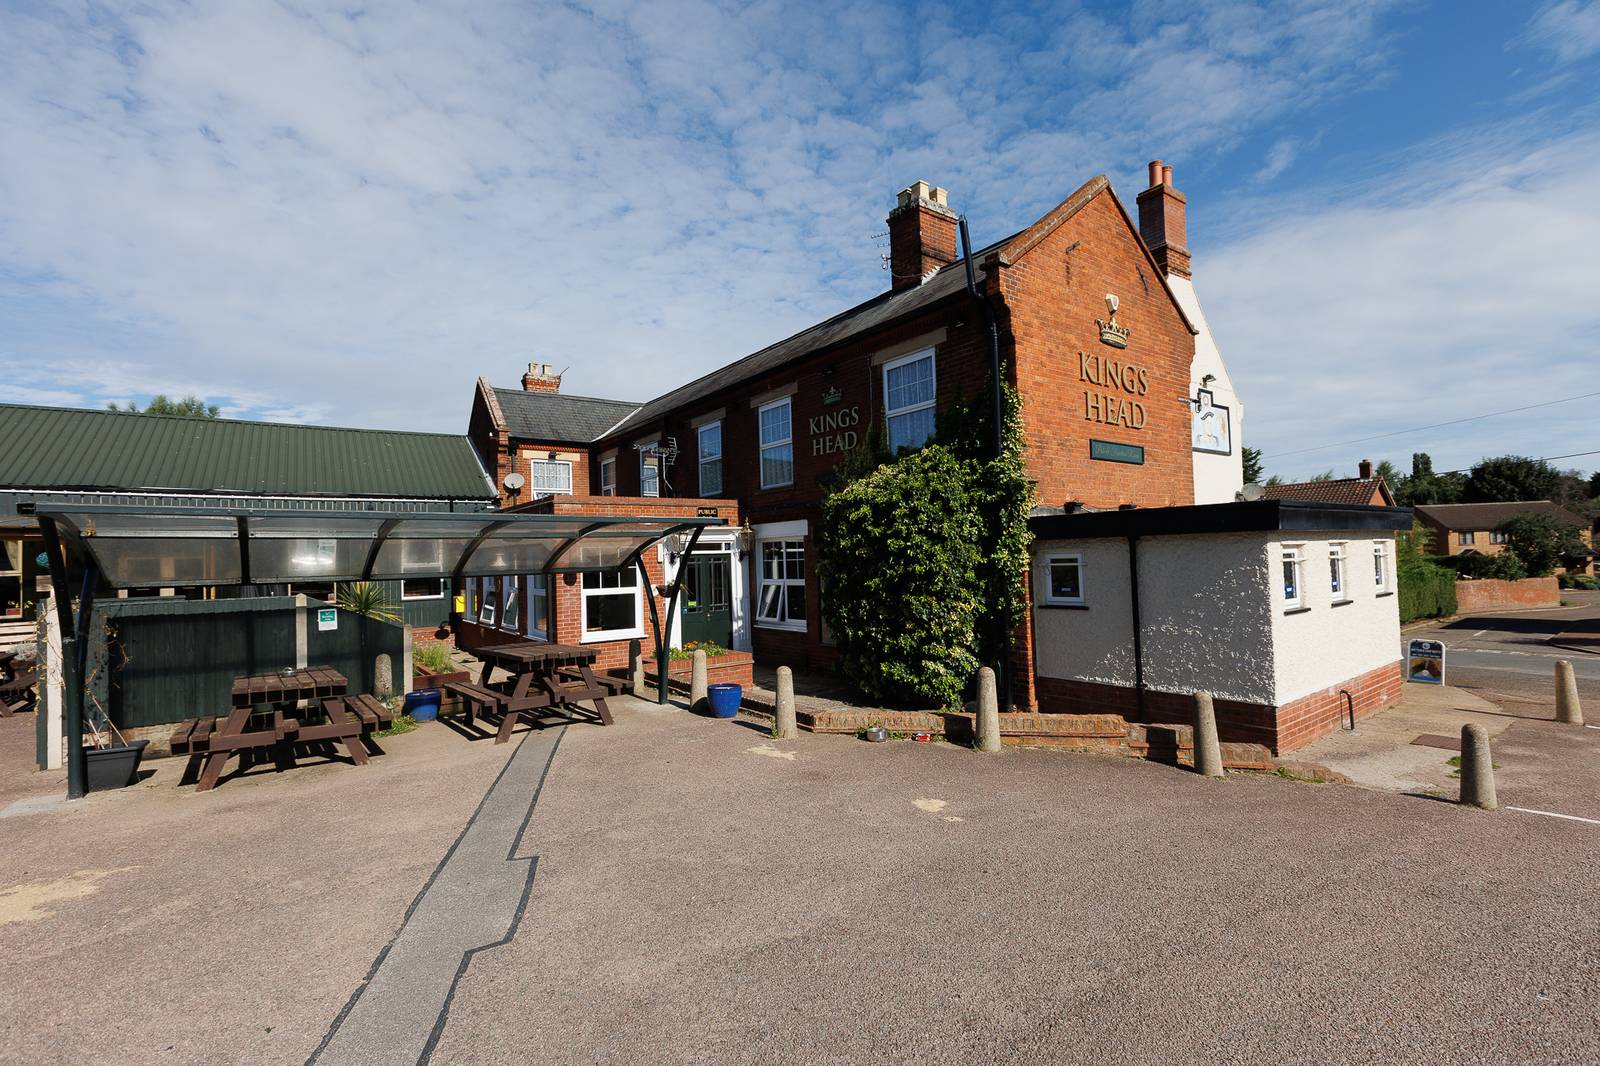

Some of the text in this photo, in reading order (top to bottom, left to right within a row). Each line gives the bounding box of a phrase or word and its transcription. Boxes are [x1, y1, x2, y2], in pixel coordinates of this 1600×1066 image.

[1079, 352, 1149, 396] KINGS
[809, 406, 859, 435] KINGS
[1084, 392, 1148, 430] HEAD
[813, 431, 857, 456] HEAD
